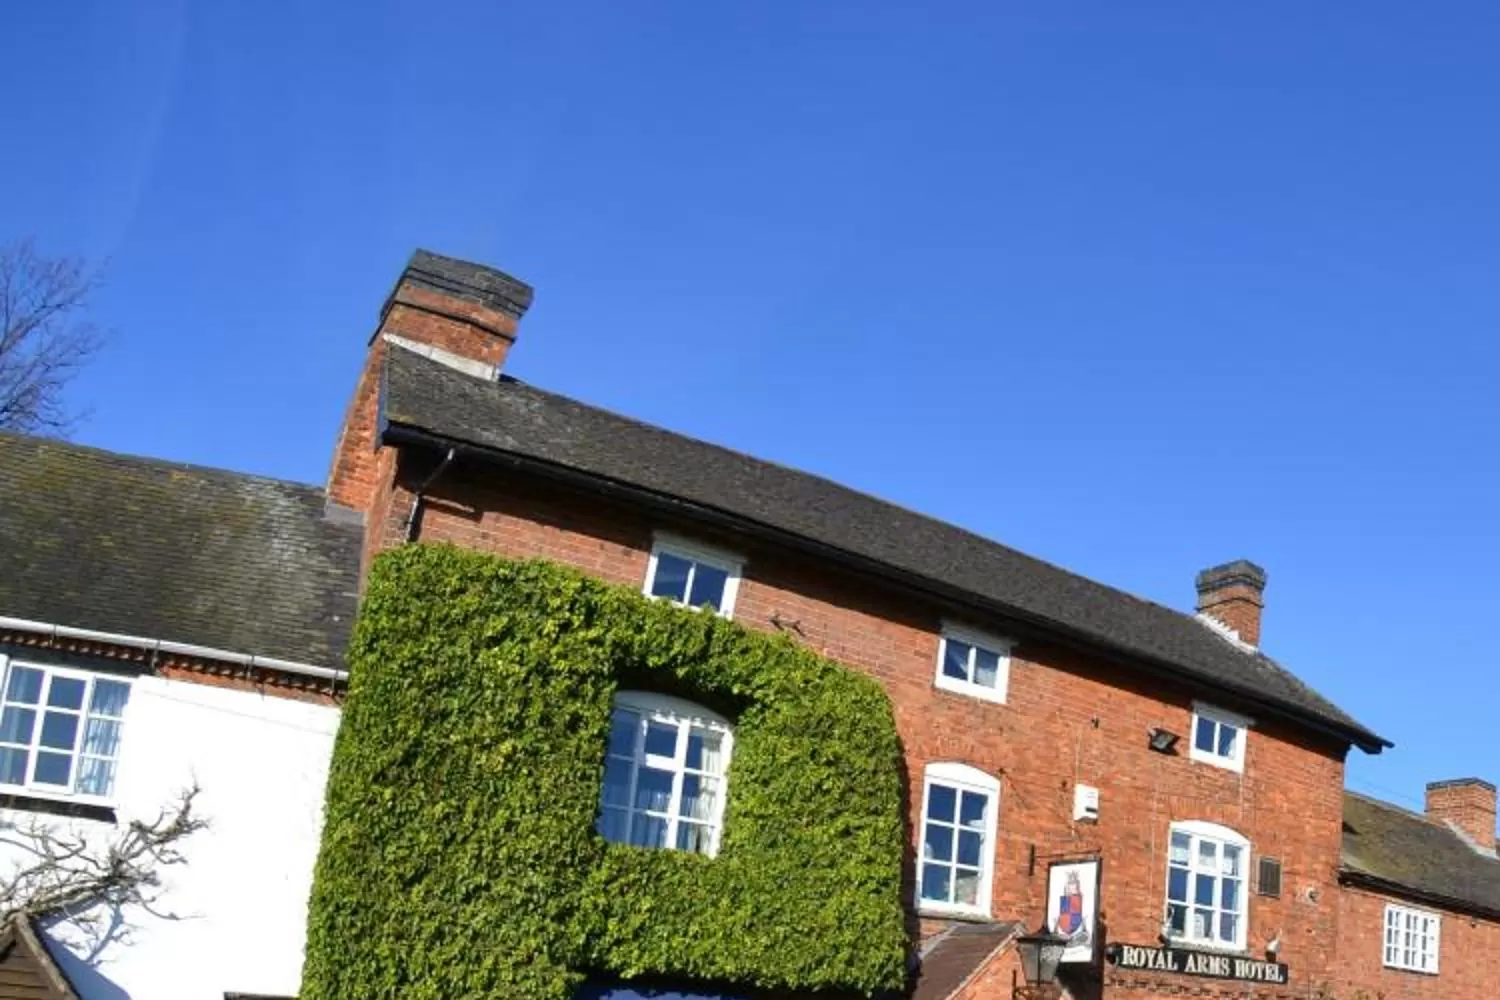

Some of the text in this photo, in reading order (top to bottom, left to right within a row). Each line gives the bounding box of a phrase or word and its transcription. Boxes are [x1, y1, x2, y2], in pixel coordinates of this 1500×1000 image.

[1122, 945, 1283, 983] ROYAL ARMS HOTEL
